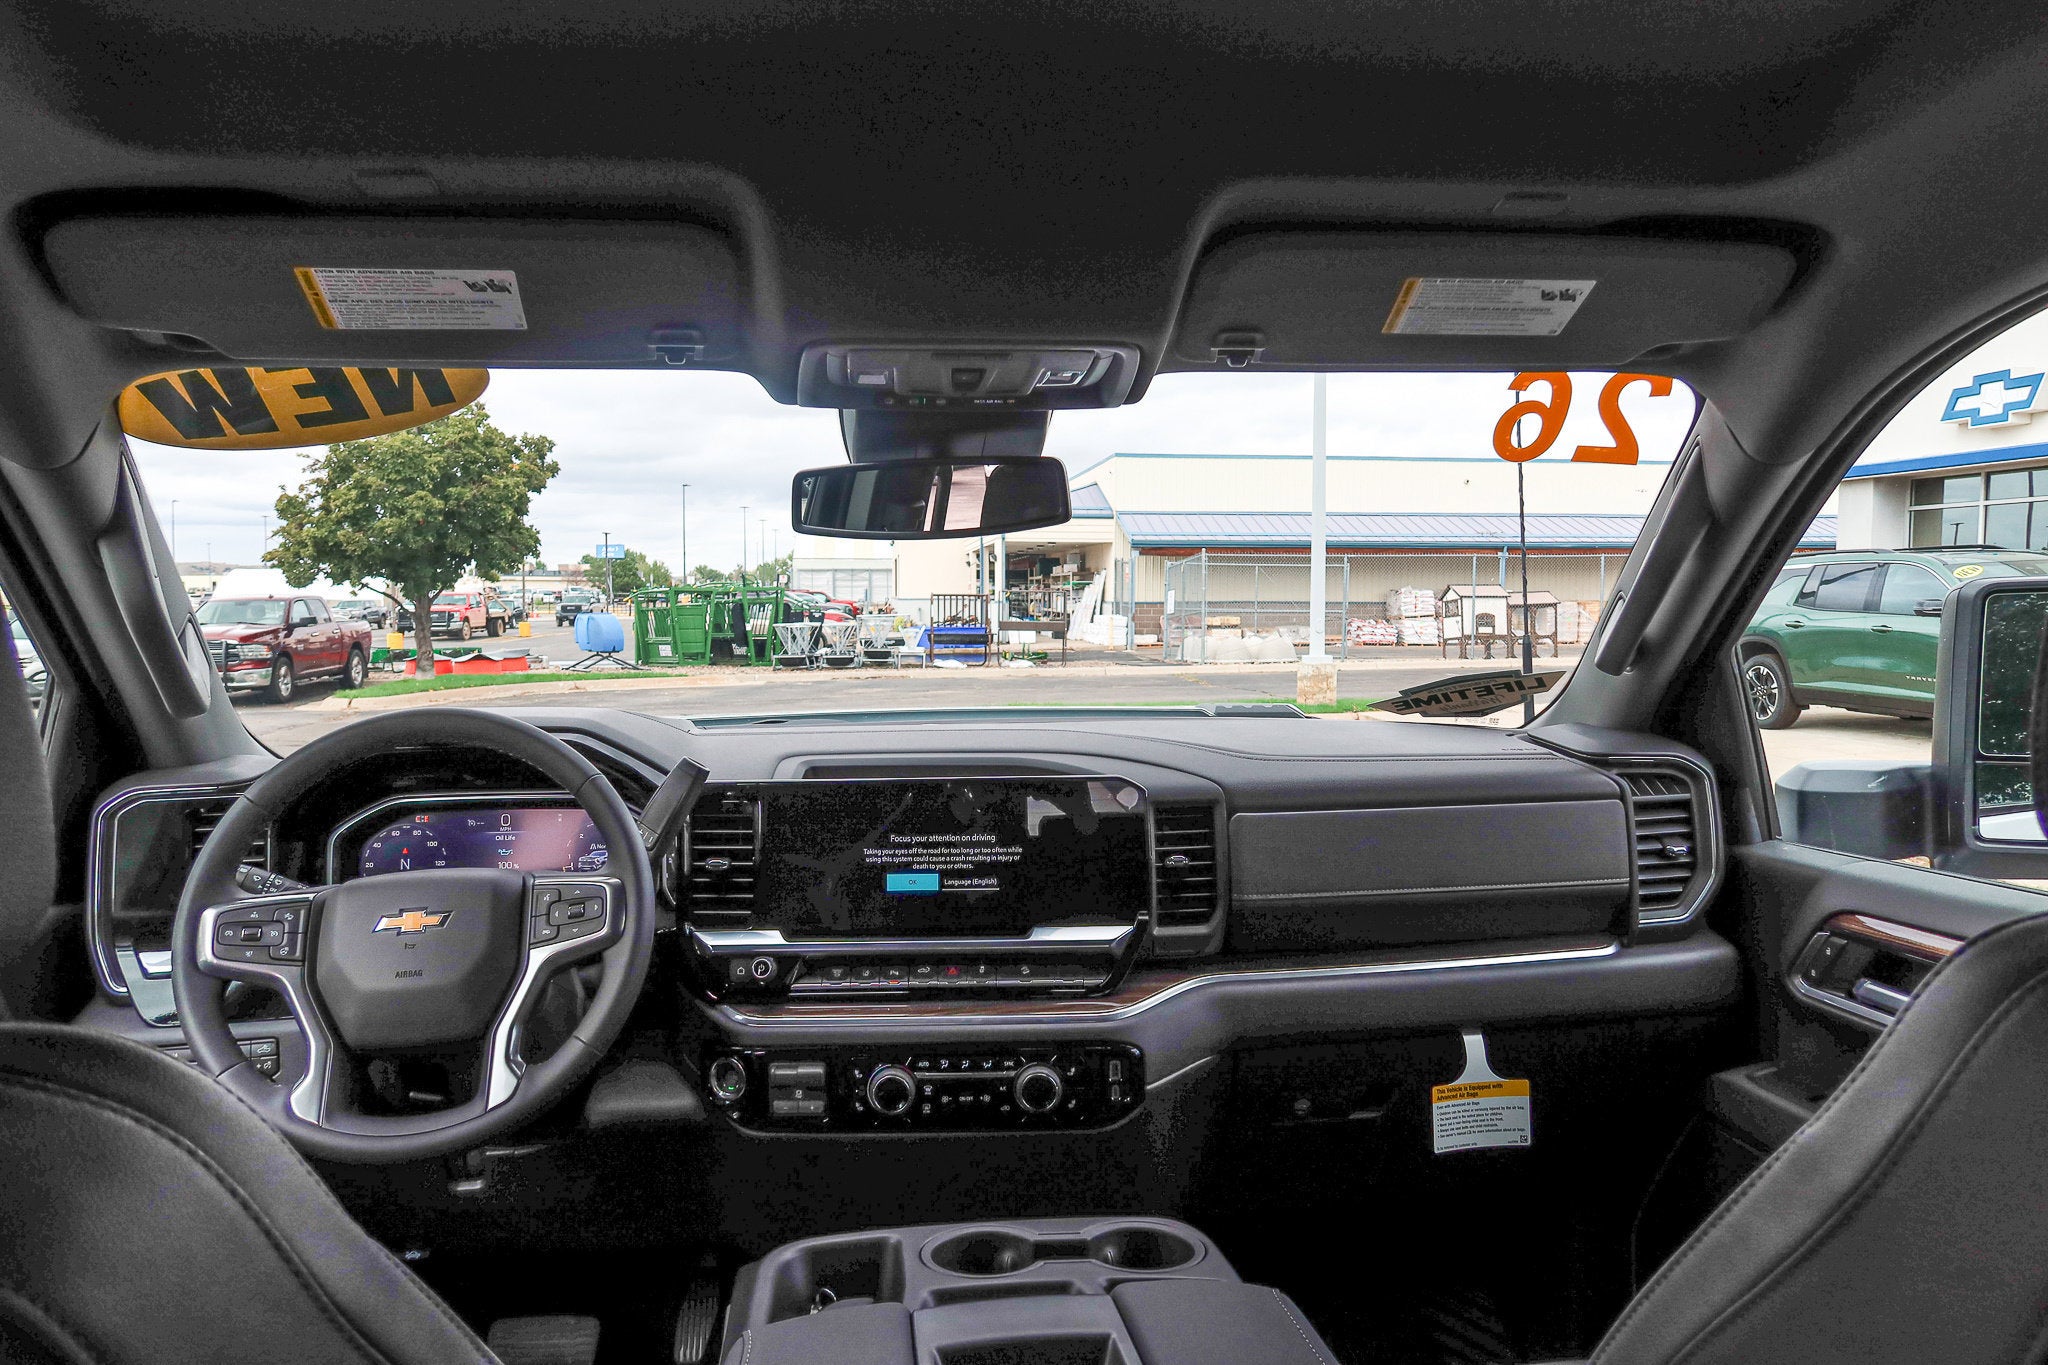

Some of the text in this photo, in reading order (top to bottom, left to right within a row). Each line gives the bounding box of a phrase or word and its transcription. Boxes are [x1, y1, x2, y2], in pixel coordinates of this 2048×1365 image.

[501, 814, 510, 826] 0
[972, 834, 995, 842] driving
[400, 859, 410, 870] N
[395, 970, 423, 979] AIRBAG
